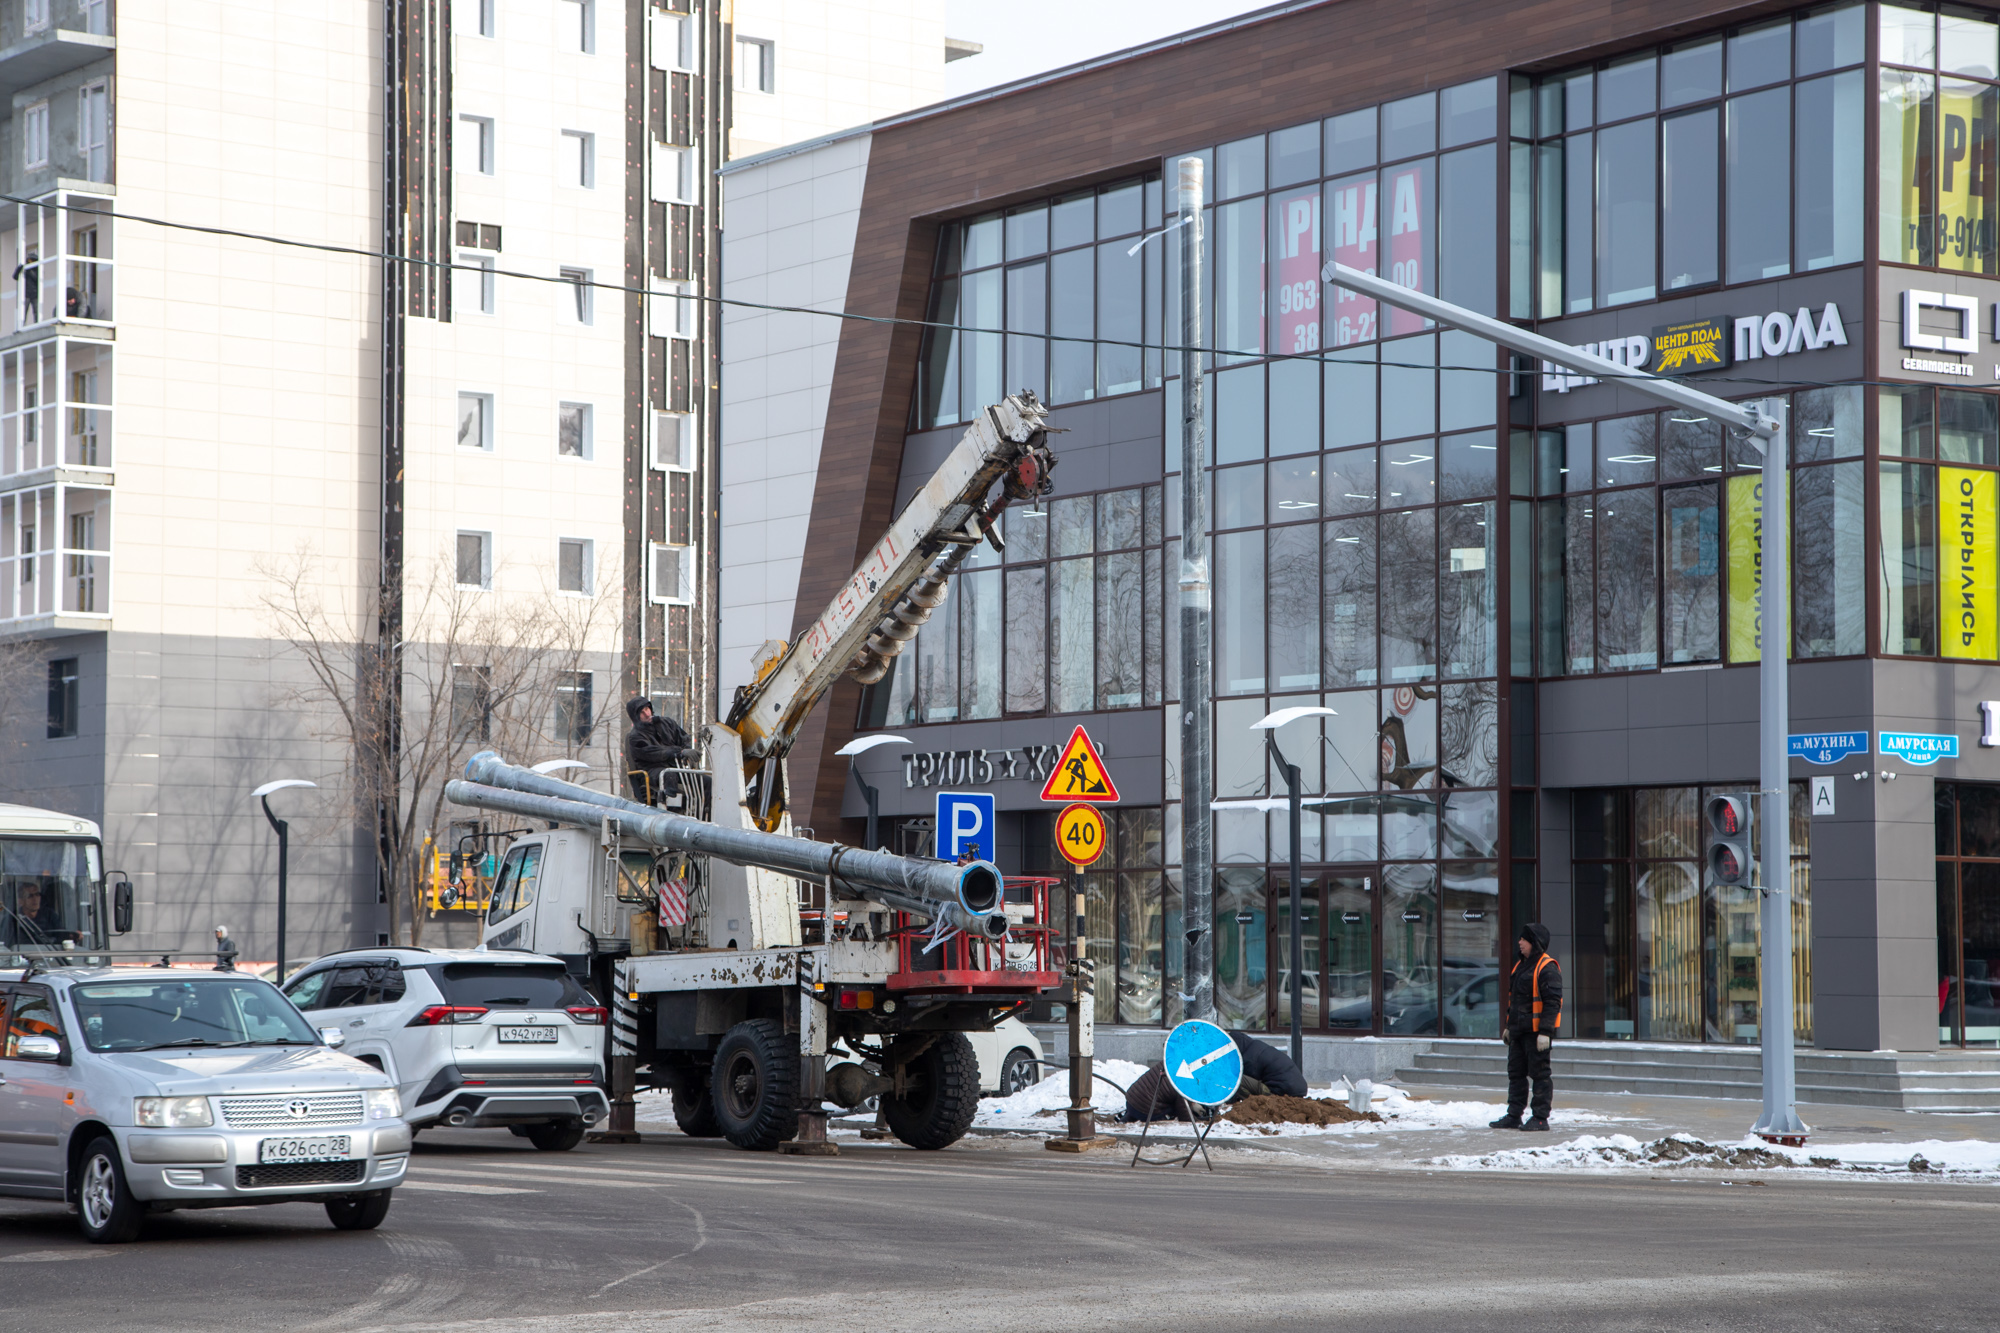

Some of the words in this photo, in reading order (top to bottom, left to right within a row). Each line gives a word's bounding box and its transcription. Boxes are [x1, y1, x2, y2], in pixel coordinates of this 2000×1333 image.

[1655, 332, 1689, 350] ЦЕНТР
[1691, 327, 1722, 344] ПОЛА
[1734, 302, 1848, 361] ПОЛА
[1903, 358, 1974, 376] CERAMOCENTR
[1959, 478, 1976, 647] ОТКРЫЛИСЬ
[1803, 736, 1856, 749] МУХИНА
[1887, 737, 1951, 751] АМУРСКАЯ
[1818, 750, 1832, 762] 45
[1907, 751, 1931, 760] улица
[901, 749, 993, 788] ГРИЛЬ
[1066, 822, 1095, 845] 40
[544, 1028, 554, 1037] 28
[331, 1138, 345, 1151] 28
